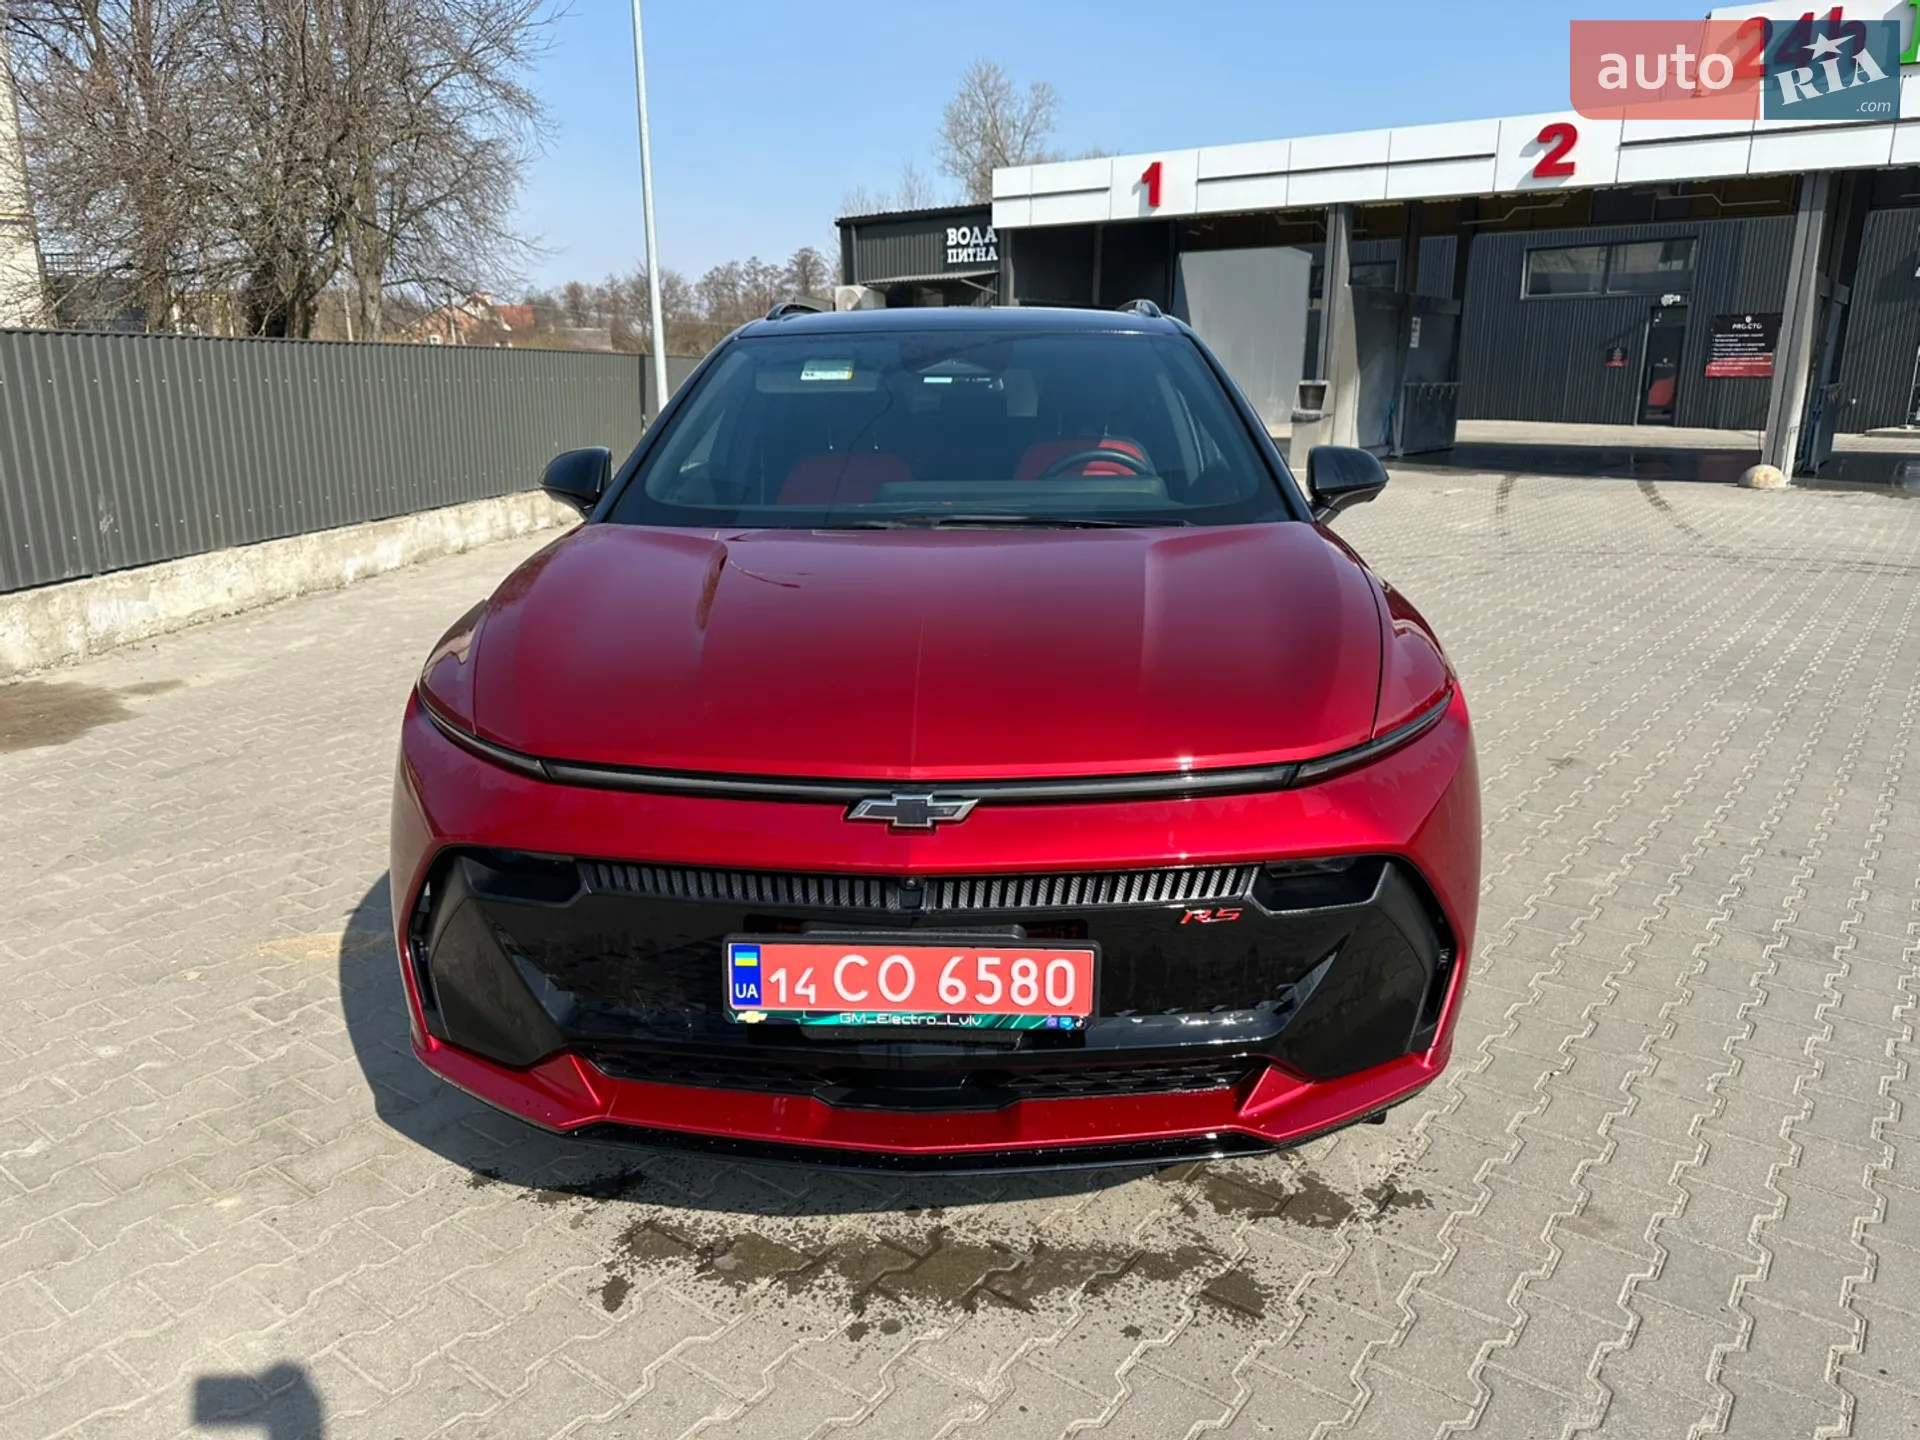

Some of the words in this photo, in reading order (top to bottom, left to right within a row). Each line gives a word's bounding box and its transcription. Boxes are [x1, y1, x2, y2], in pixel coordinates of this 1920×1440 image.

[1533, 122, 1578, 178] 2
[1141, 161, 1163, 207] 1
[946, 225, 998, 247] ВОДА
[946, 246, 999, 263] ПИТНА
[1180, 907, 1243, 924] RS
[735, 983, 759, 999] UA
[768, 967, 816, 1004] 14
[833, 954, 916, 1003] CO
[938, 956, 1075, 1007] 6580
